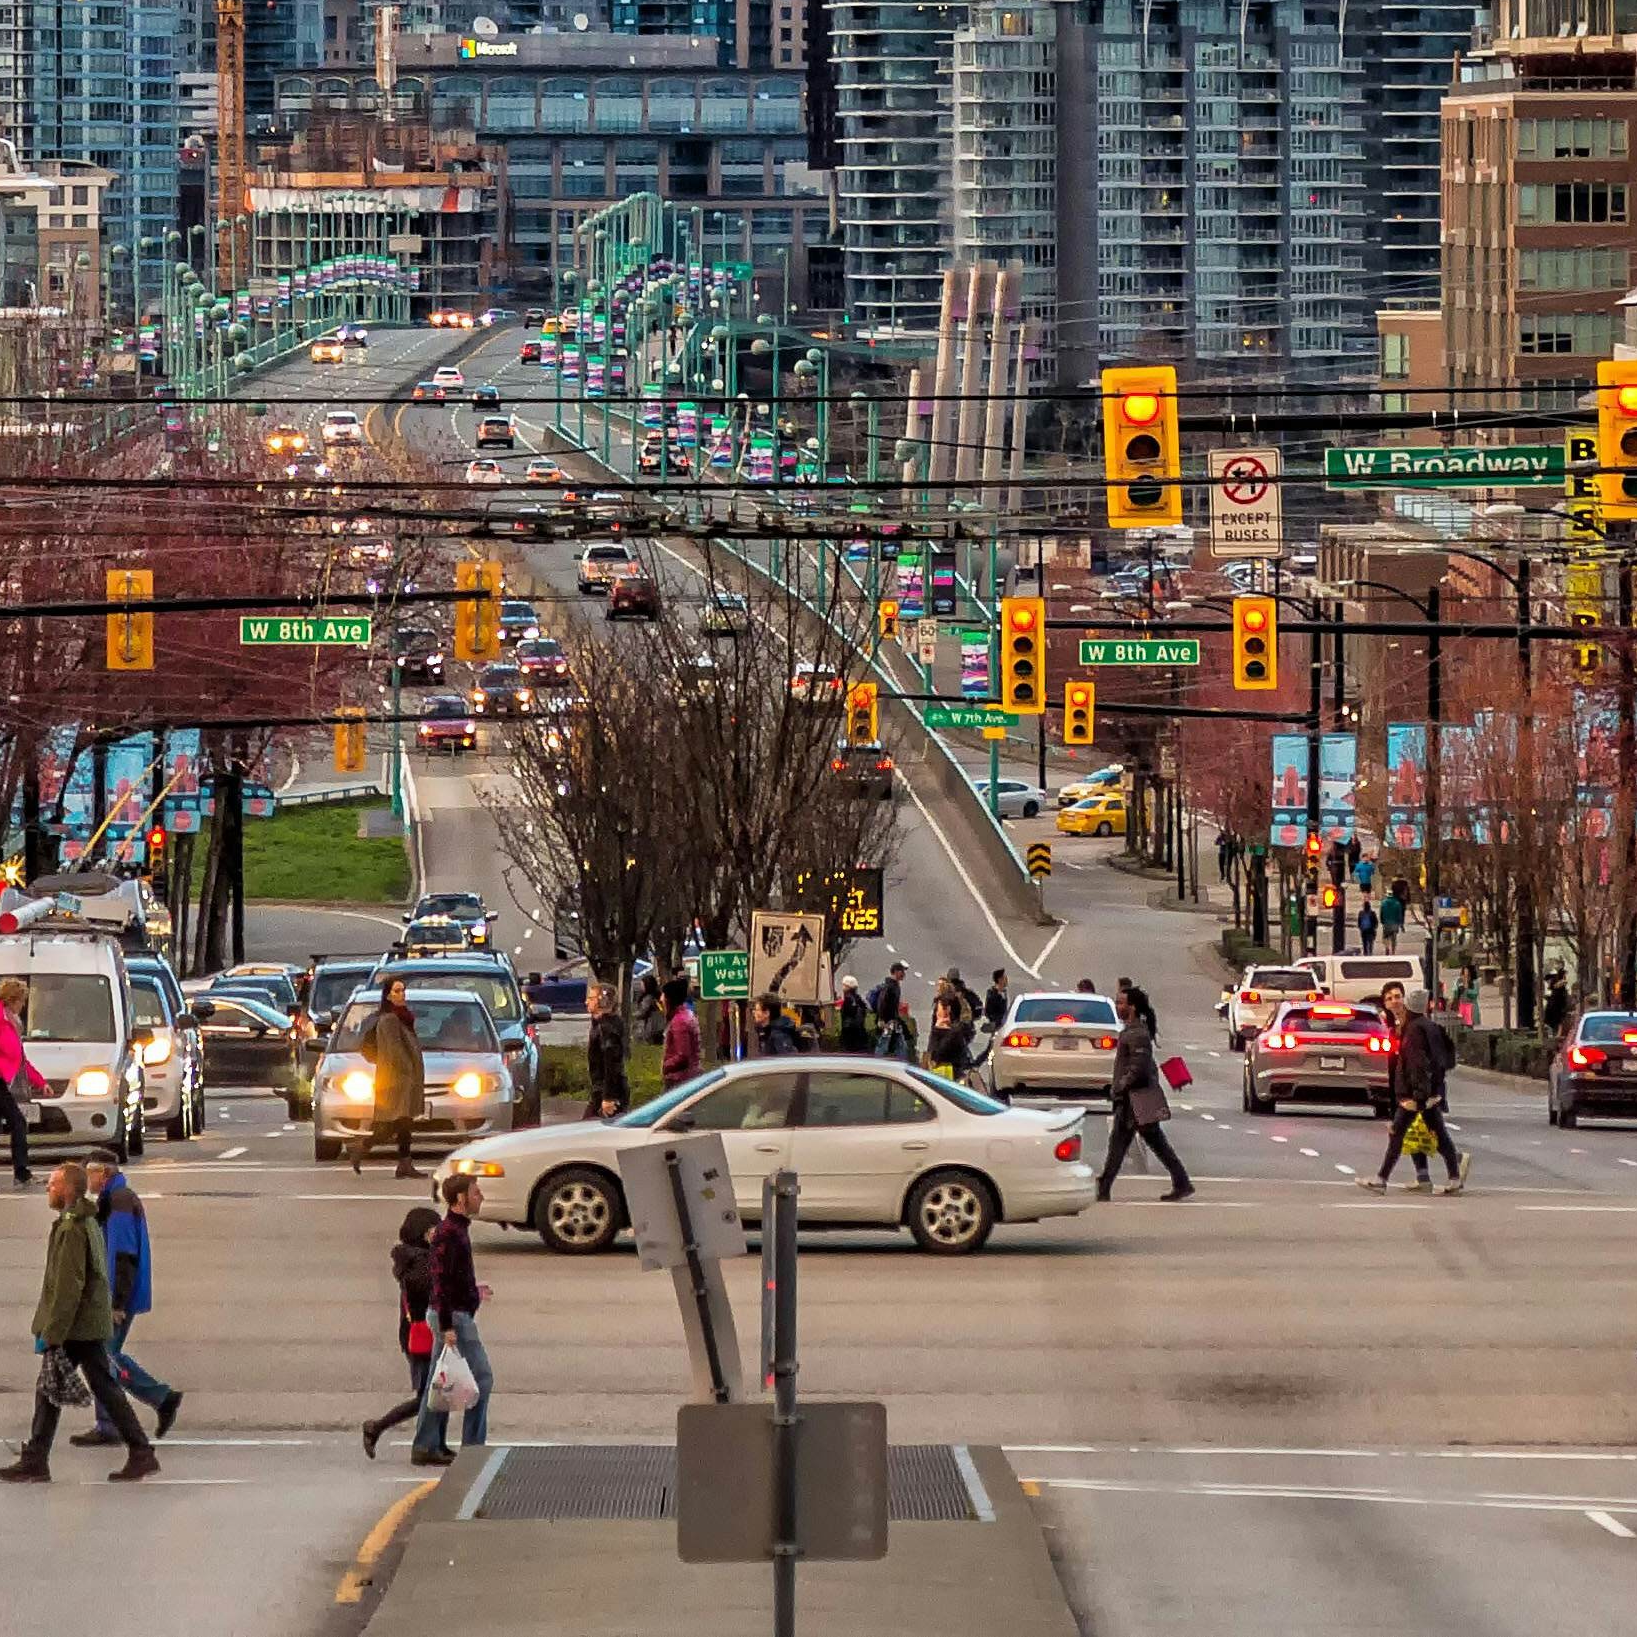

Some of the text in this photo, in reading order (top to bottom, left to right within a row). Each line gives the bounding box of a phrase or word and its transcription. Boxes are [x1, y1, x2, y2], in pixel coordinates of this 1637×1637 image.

[476, 41, 517, 55] Microsoft
[1344, 451, 1548, 481] W Broadway
[1221, 512, 1271, 525] EXCEPT
[1225, 529, 1269, 542] BUSES
[250, 621, 362, 640] W 8th Ave
[920, 626, 935, 636] 60
[1088, 644, 1191, 661] W 8th Ave
[951, 713, 962, 724] W
[964, 713, 982, 725] 7th
[706, 955, 726, 968] 8th
